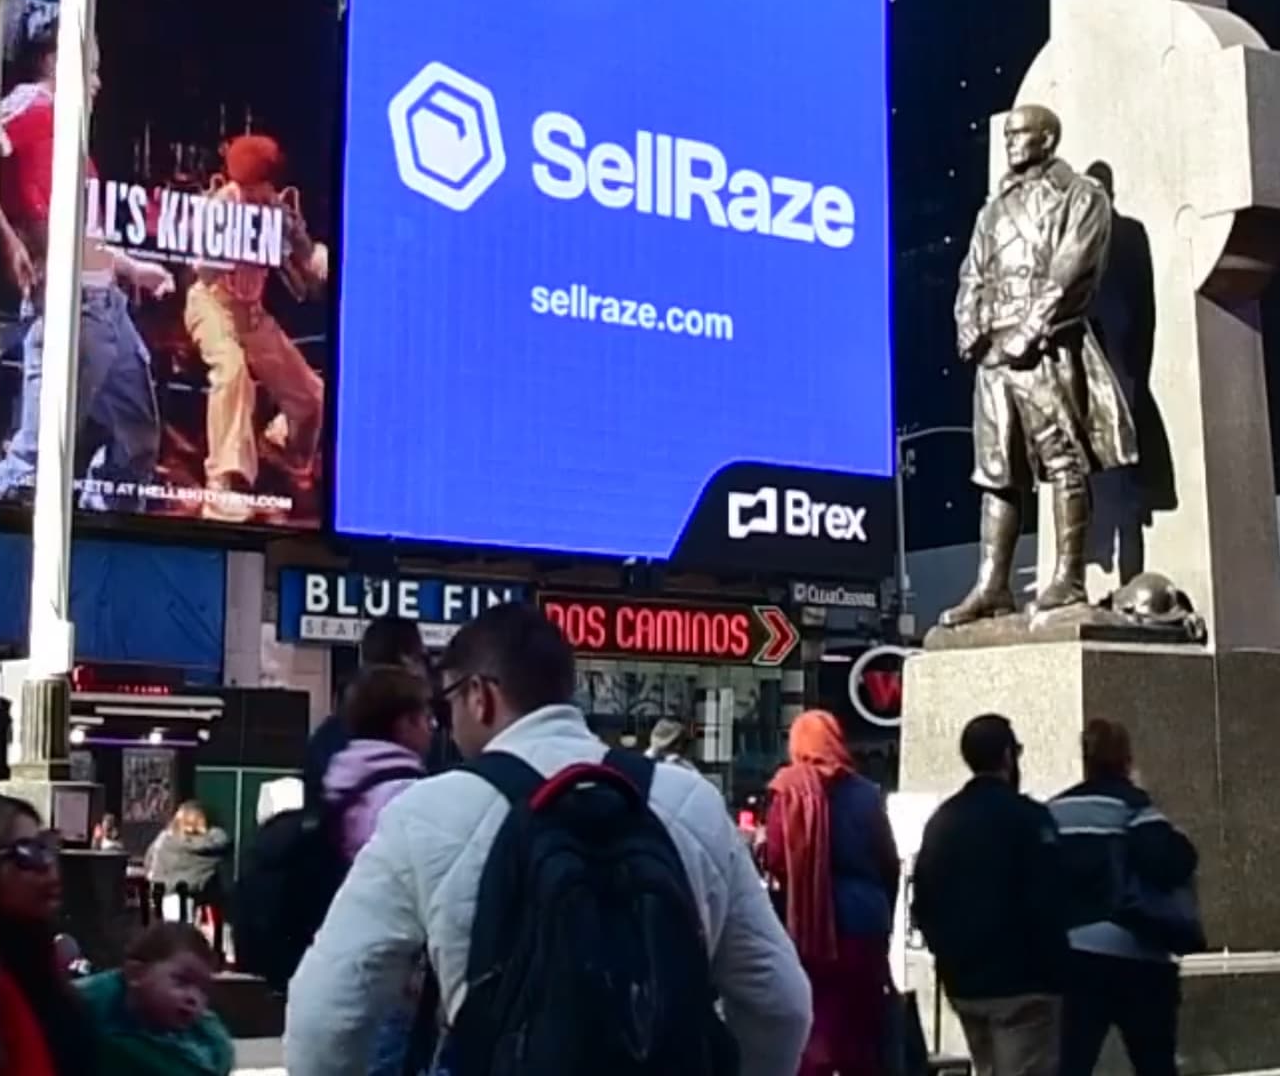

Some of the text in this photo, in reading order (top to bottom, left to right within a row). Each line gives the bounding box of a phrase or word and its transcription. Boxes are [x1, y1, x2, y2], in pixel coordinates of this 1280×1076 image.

[532, 111, 855, 249] SellRaze
[85, 178, 283, 267] LL'S KITCHEN
[531, 284, 734, 341] sellraze.com
[74, 478, 114, 494] KETS
[117, 485, 137, 498] AT
[785, 489, 867, 542] Brex
[305, 574, 420, 619] BLUE
[545, 602, 749, 656] DOS CAMINOS
